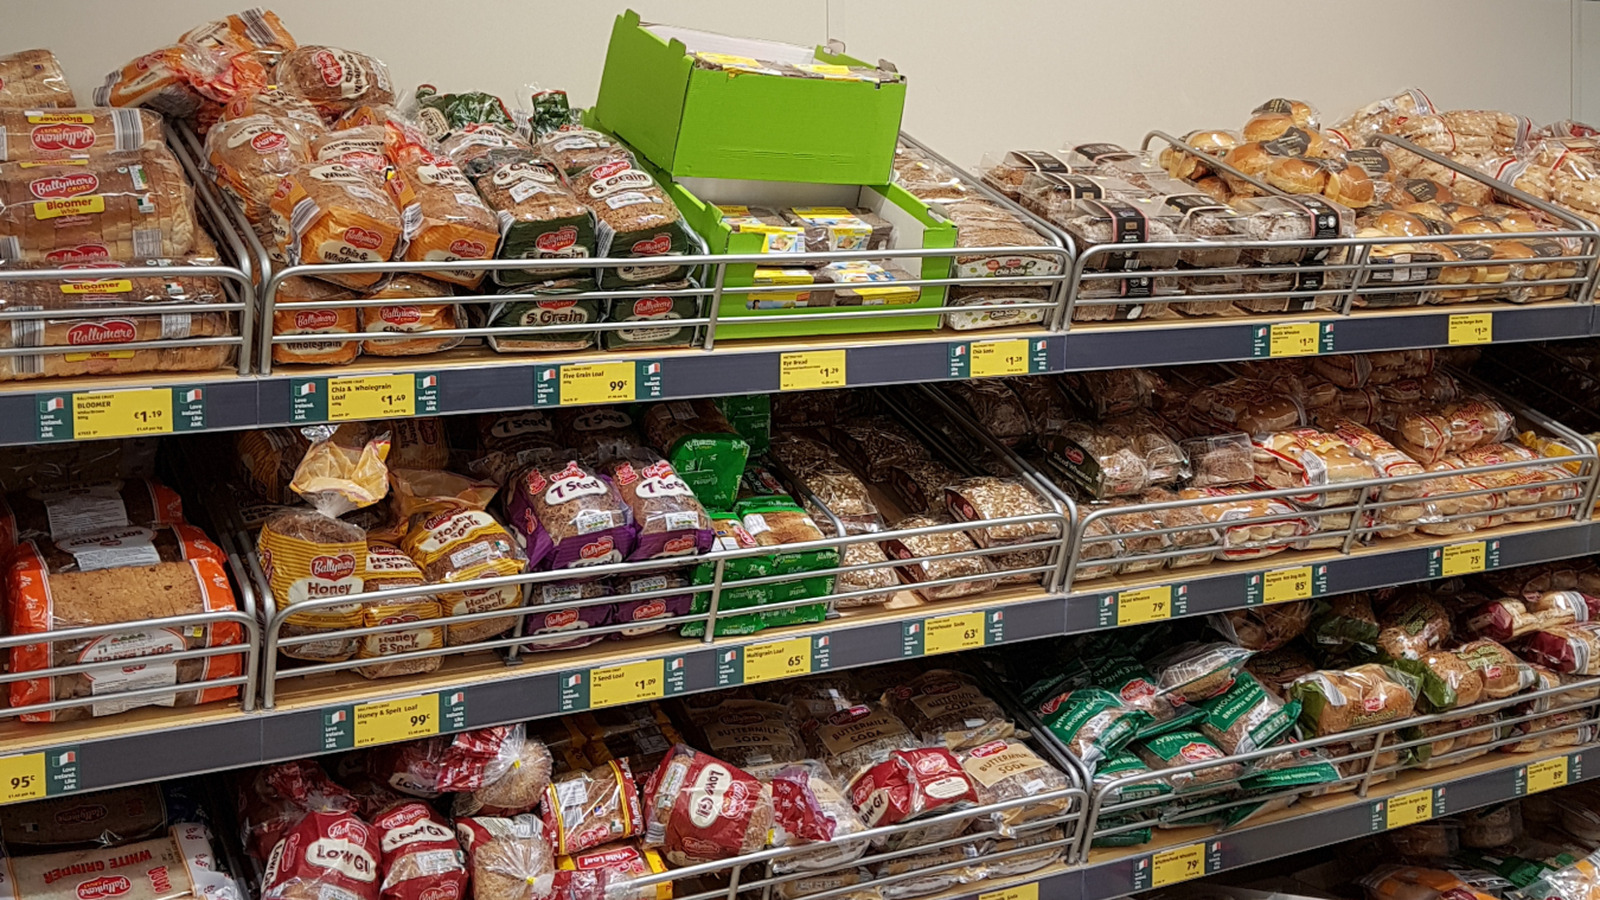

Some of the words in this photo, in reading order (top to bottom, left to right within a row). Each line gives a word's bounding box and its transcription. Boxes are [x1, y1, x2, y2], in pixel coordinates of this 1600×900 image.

[34, 174, 97, 195] Ballymore
[46, 197, 93, 211] Bloomer
[73, 282, 119, 290] Bloomer
[540, 310, 584, 323] Grain
[354, 383, 392, 393] Wholegrain
[331, 393, 346, 401] Loaf
[381, 394, 406, 406] €1.49
[77, 401, 111, 409] BLOOMER
[134, 410, 163, 422] €1.19
[551, 486, 564, 498] 7
[567, 479, 601, 492] Seed
[643, 482, 655, 493] 7
[307, 582, 352, 596] Honey
[465, 588, 503, 609] Honey
[477, 599, 506, 612] Spelt
[746, 650, 773, 659] Multigrain
[612, 672, 625, 680] Loaf
[635, 678, 656, 690] €1.09
[1212, 693, 1234, 716] WHOLE
[1221, 700, 1247, 720] BROWN
[357, 711, 378, 720] Honey
[385, 707, 402, 716] Spelt
[404, 704, 418, 712] Loaf
[717, 728, 780, 738] BUTTERMILK
[832, 718, 890, 742] BUTTERMILK
[733, 736, 770, 744] SODA
[979, 751, 1029, 772] BUTTERMILK
[999, 762, 1026, 775] SODA
[54, 772, 76, 780] Ireland.
[109, 849, 153, 869] WHITE
[605, 850, 632, 860] White
[43, 860, 106, 884] GRINDER
